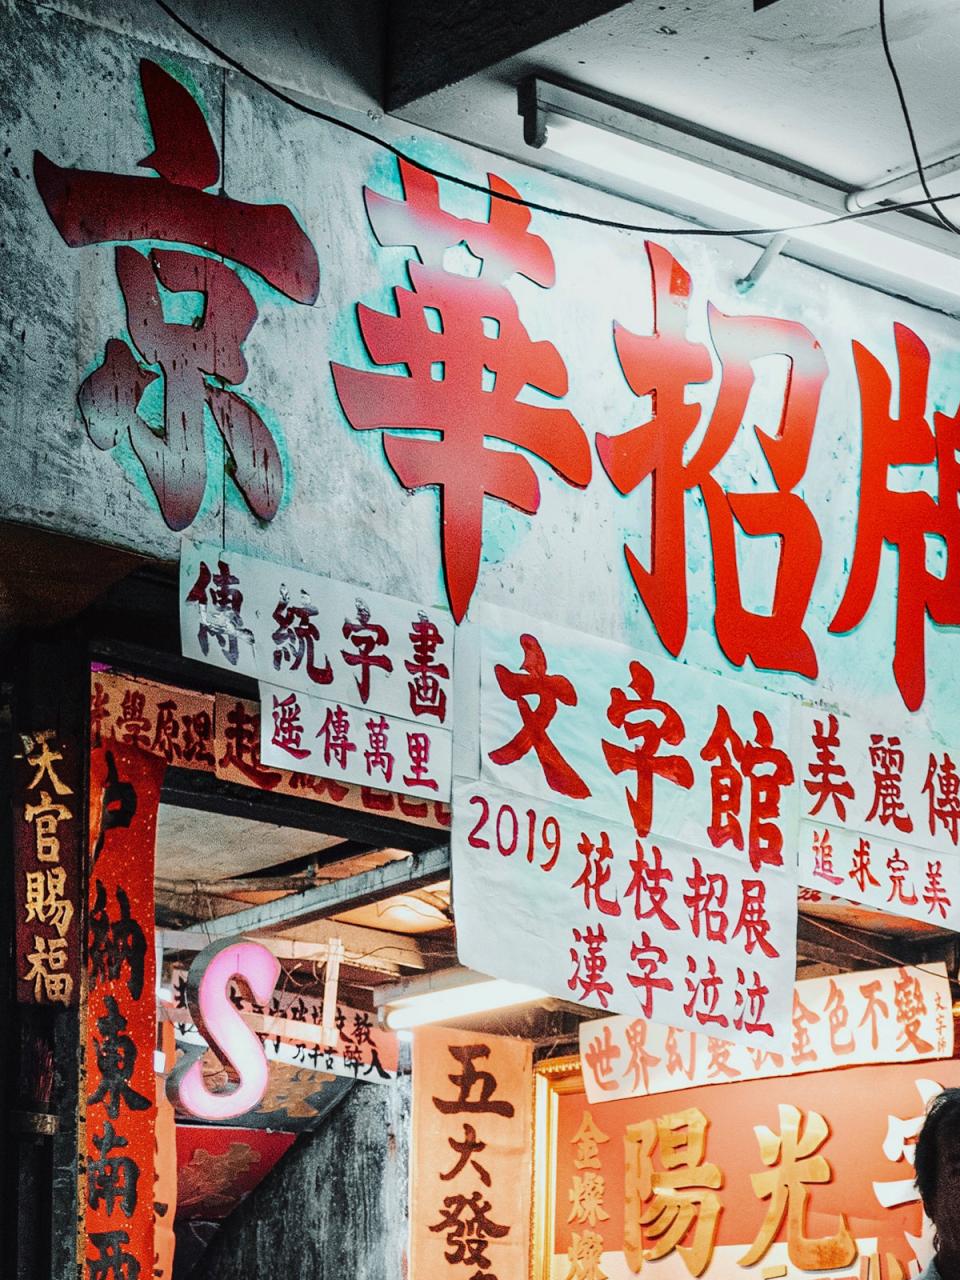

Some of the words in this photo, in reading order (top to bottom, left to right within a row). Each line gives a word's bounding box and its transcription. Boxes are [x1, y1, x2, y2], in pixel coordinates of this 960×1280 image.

[488, 633, 795, 872] 文字館
[467, 795, 560, 872] 2019
[570, 830, 780, 960] 花枝招展
[812, 827, 953, 920] 追求完美
